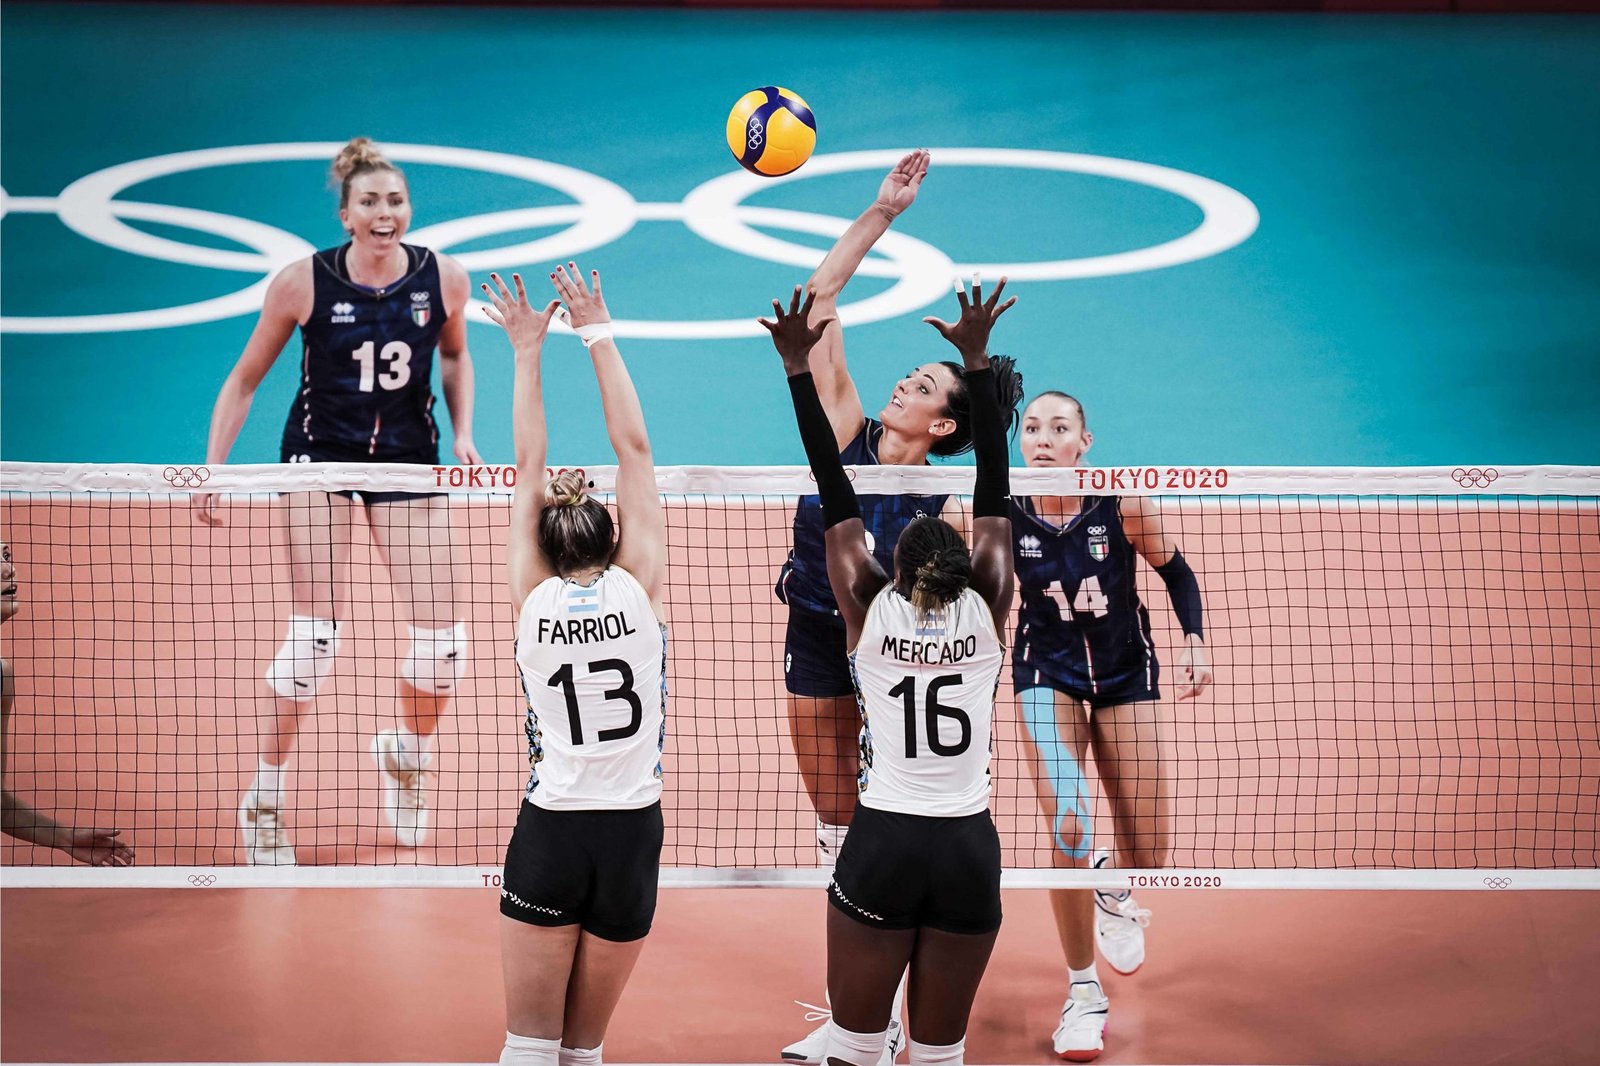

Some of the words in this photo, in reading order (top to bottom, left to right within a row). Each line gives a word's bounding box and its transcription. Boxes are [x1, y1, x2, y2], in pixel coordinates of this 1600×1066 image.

[352, 340, 412, 392] 13
[432, 466, 516, 488] TOKYO
[1075, 468, 1159, 489] TOKYO
[1166, 468, 1228, 488] 2020
[1042, 575, 1109, 621] 14
[538, 611, 636, 645] FARRIOL
[881, 634, 976, 665] MERCADO
[547, 658, 643, 746] 13
[888, 673, 972, 759] 16
[1128, 876, 1180, 887] TOKYO
[1184, 876, 1222, 887] 2020
